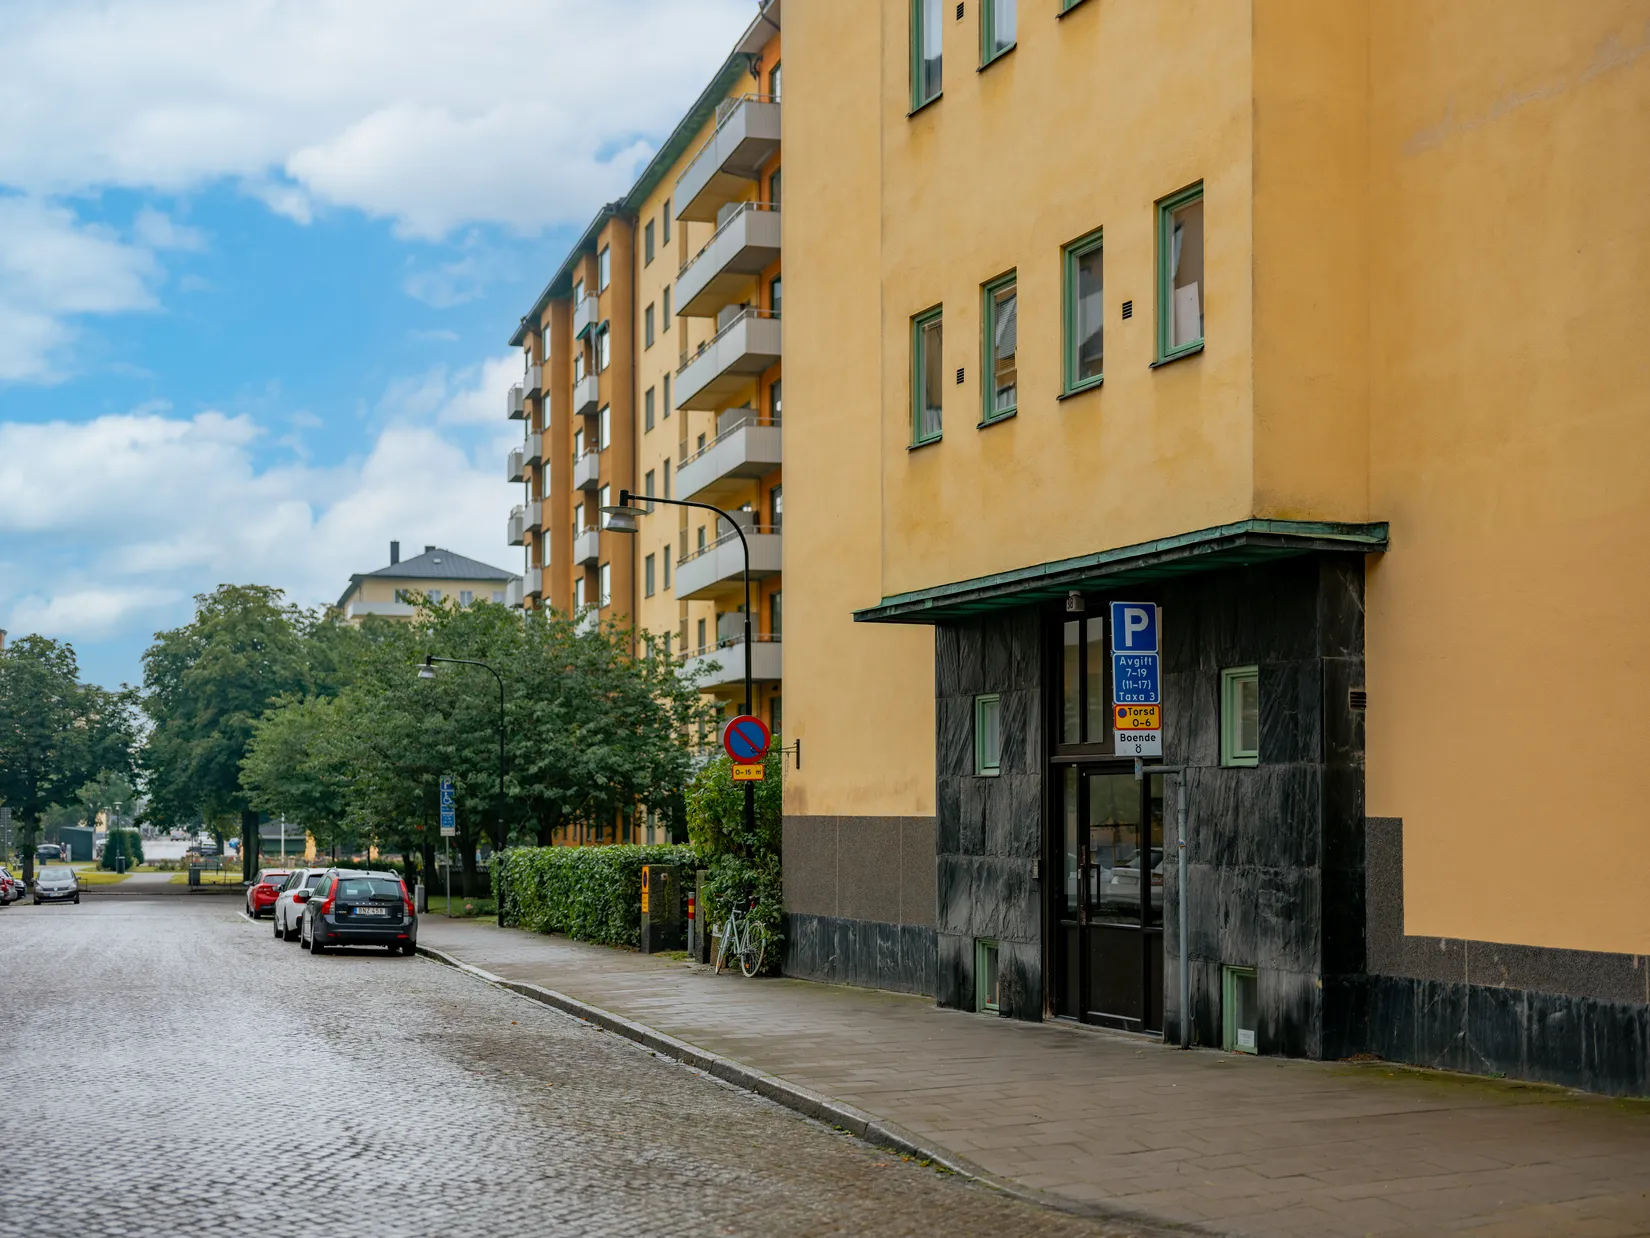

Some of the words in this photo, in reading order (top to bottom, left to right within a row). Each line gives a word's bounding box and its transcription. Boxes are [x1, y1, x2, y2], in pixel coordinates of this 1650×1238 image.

[1124, 607, 1149, 647] P
[1119, 656, 1152, 667] Avgift
[1126, 668, 1147, 677] 7-19
[1122, 680, 1151, 690] (11-17)
[1119, 692, 1145, 701] Taxa
[1149, 691, 1155, 701] 3
[1127, 707, 1155, 716] Torsd
[1132, 718, 1151, 727] 0-6
[1120, 733, 1156, 742] Boende
